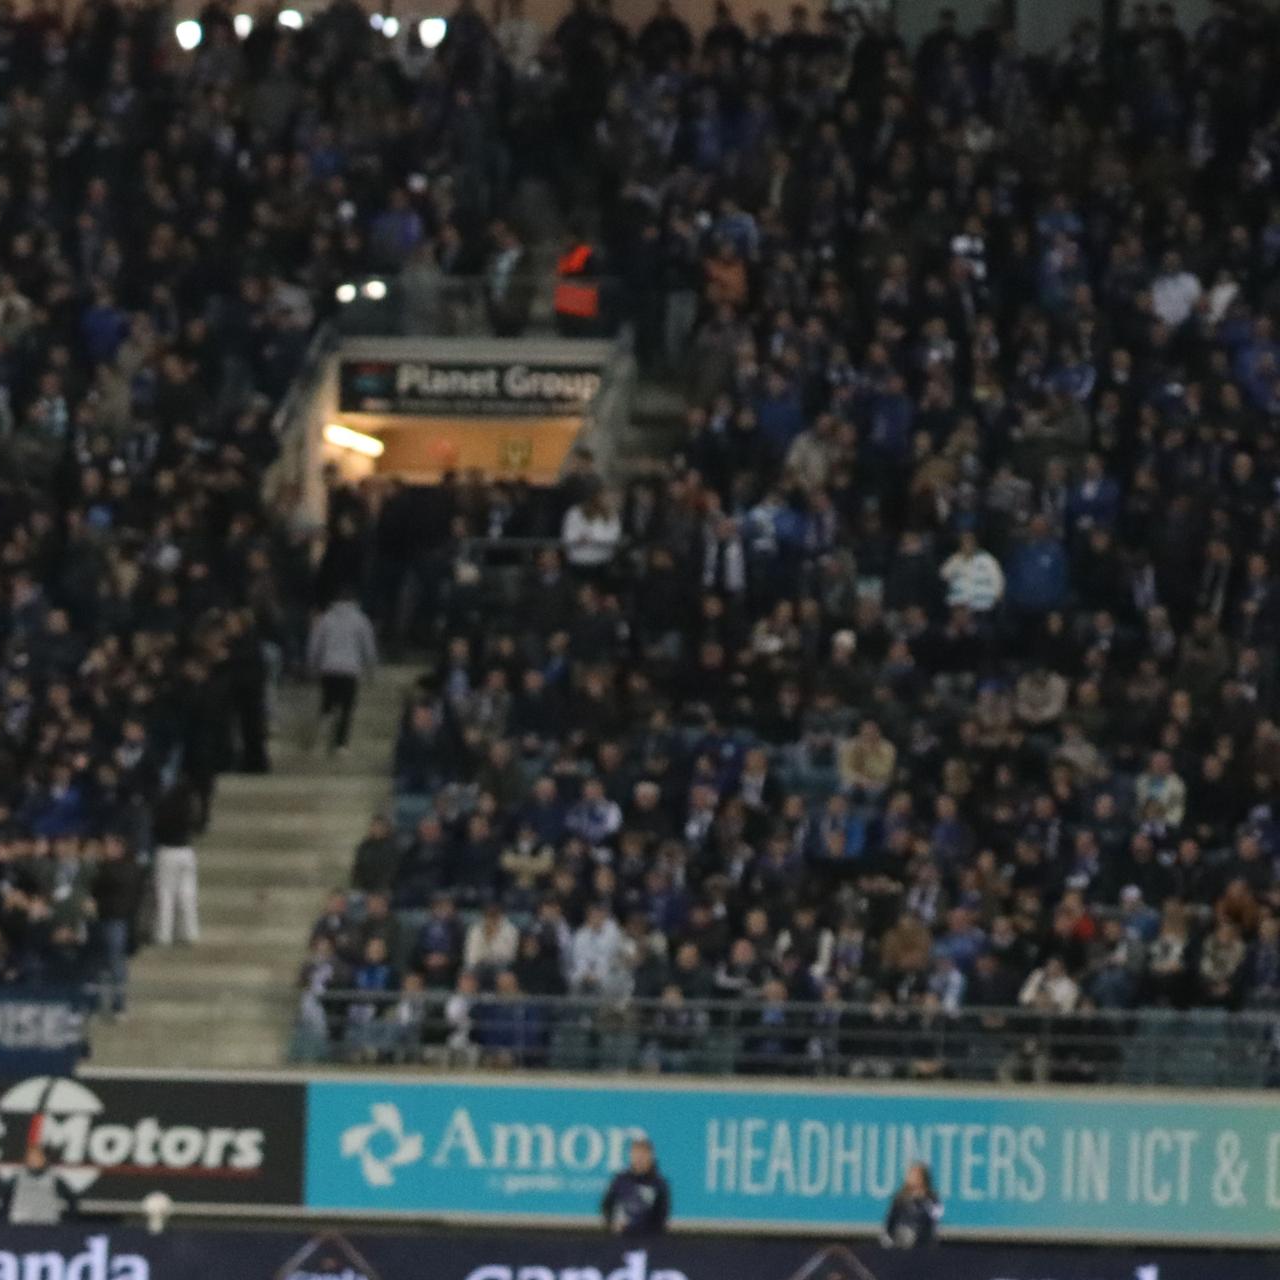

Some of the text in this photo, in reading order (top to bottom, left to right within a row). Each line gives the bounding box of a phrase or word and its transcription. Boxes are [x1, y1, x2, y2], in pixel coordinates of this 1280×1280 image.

[396, 362, 602, 400] Planet Group
[40, 1113, 264, 1171] Motors
[704, 1117, 1047, 1203] HEADHUNTERS
[1061, 1127, 1111, 1203] IN
[1126, 1127, 1200, 1206] ICT
[1209, 1128, 1249, 1207] &
